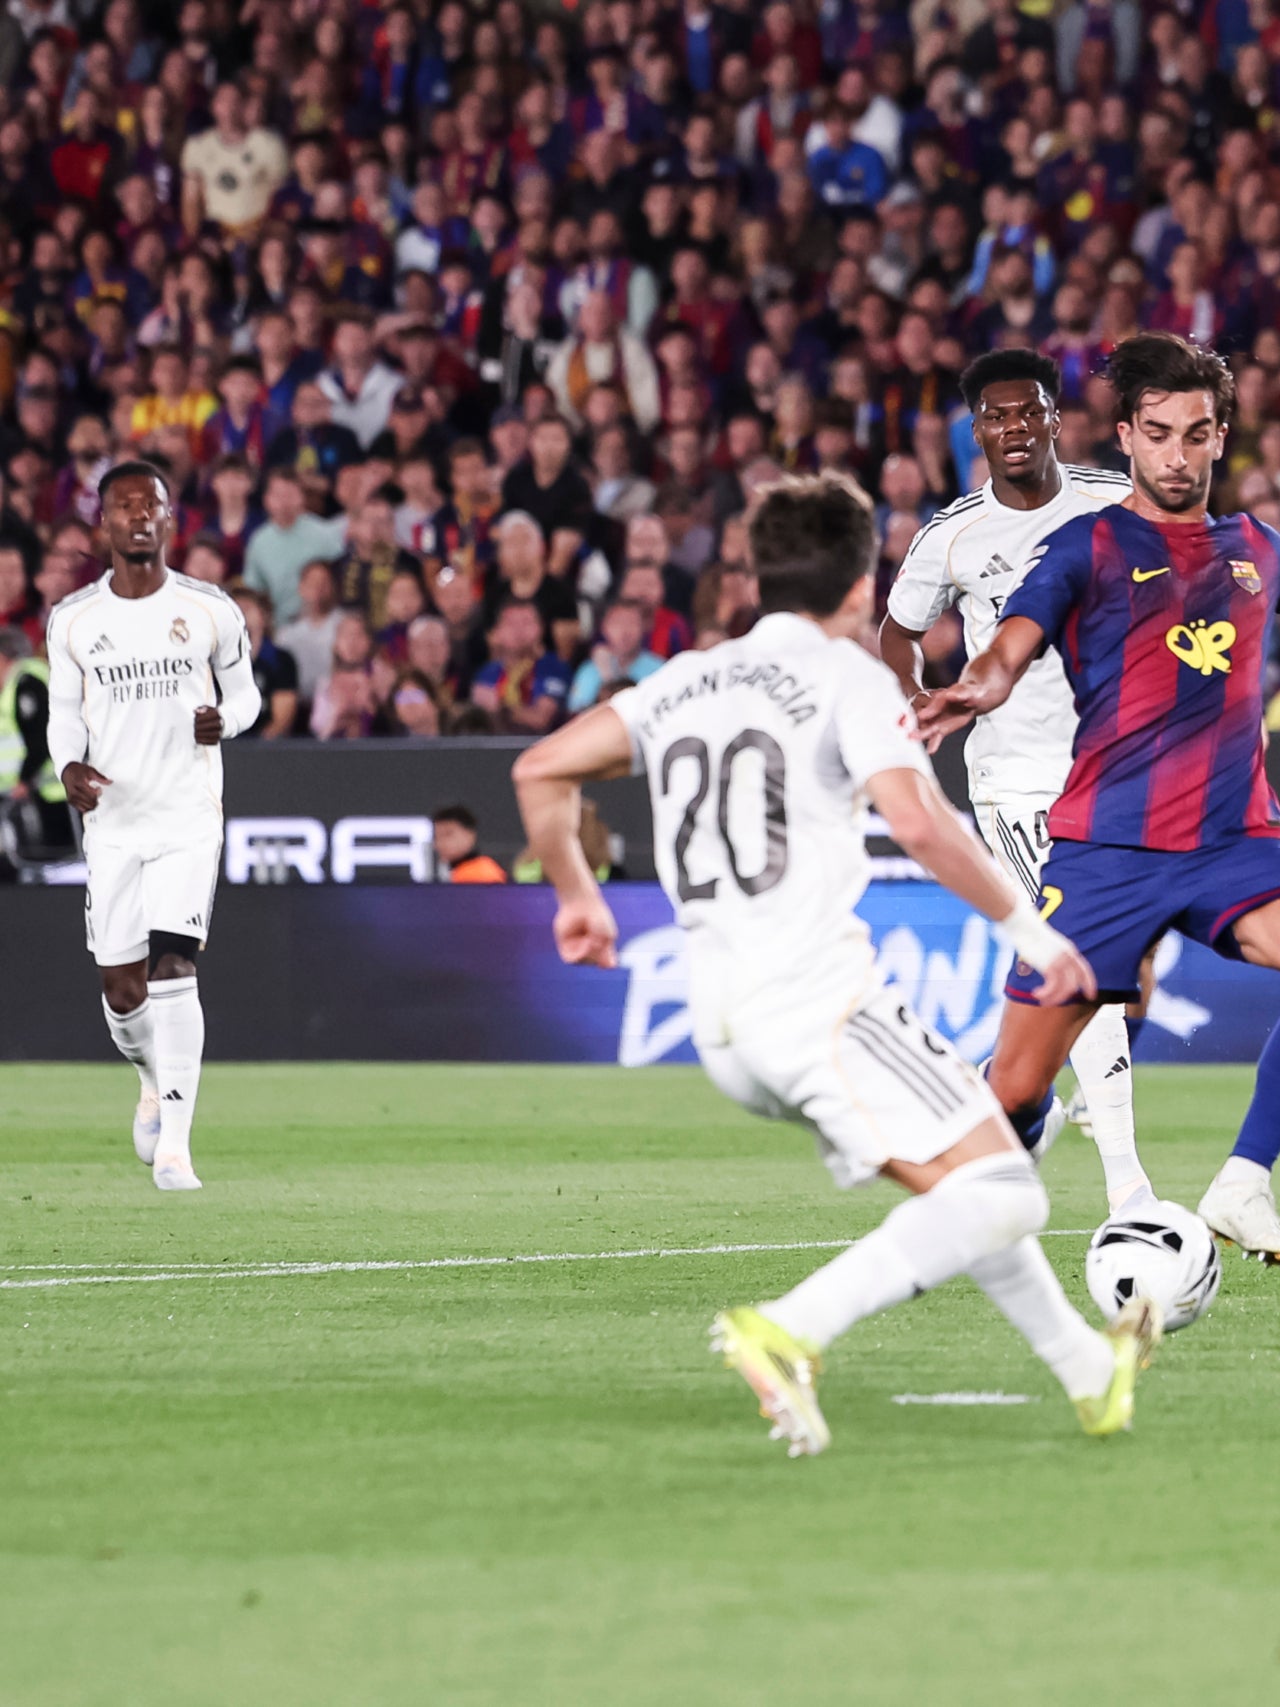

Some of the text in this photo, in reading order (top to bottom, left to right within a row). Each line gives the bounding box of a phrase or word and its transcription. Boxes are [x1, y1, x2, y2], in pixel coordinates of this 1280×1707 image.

[94, 657, 193, 686] Emirates
[113, 679, 179, 704] FLY BETTER
[662, 728, 788, 903] 20
[1040, 885, 1064, 922] 7
